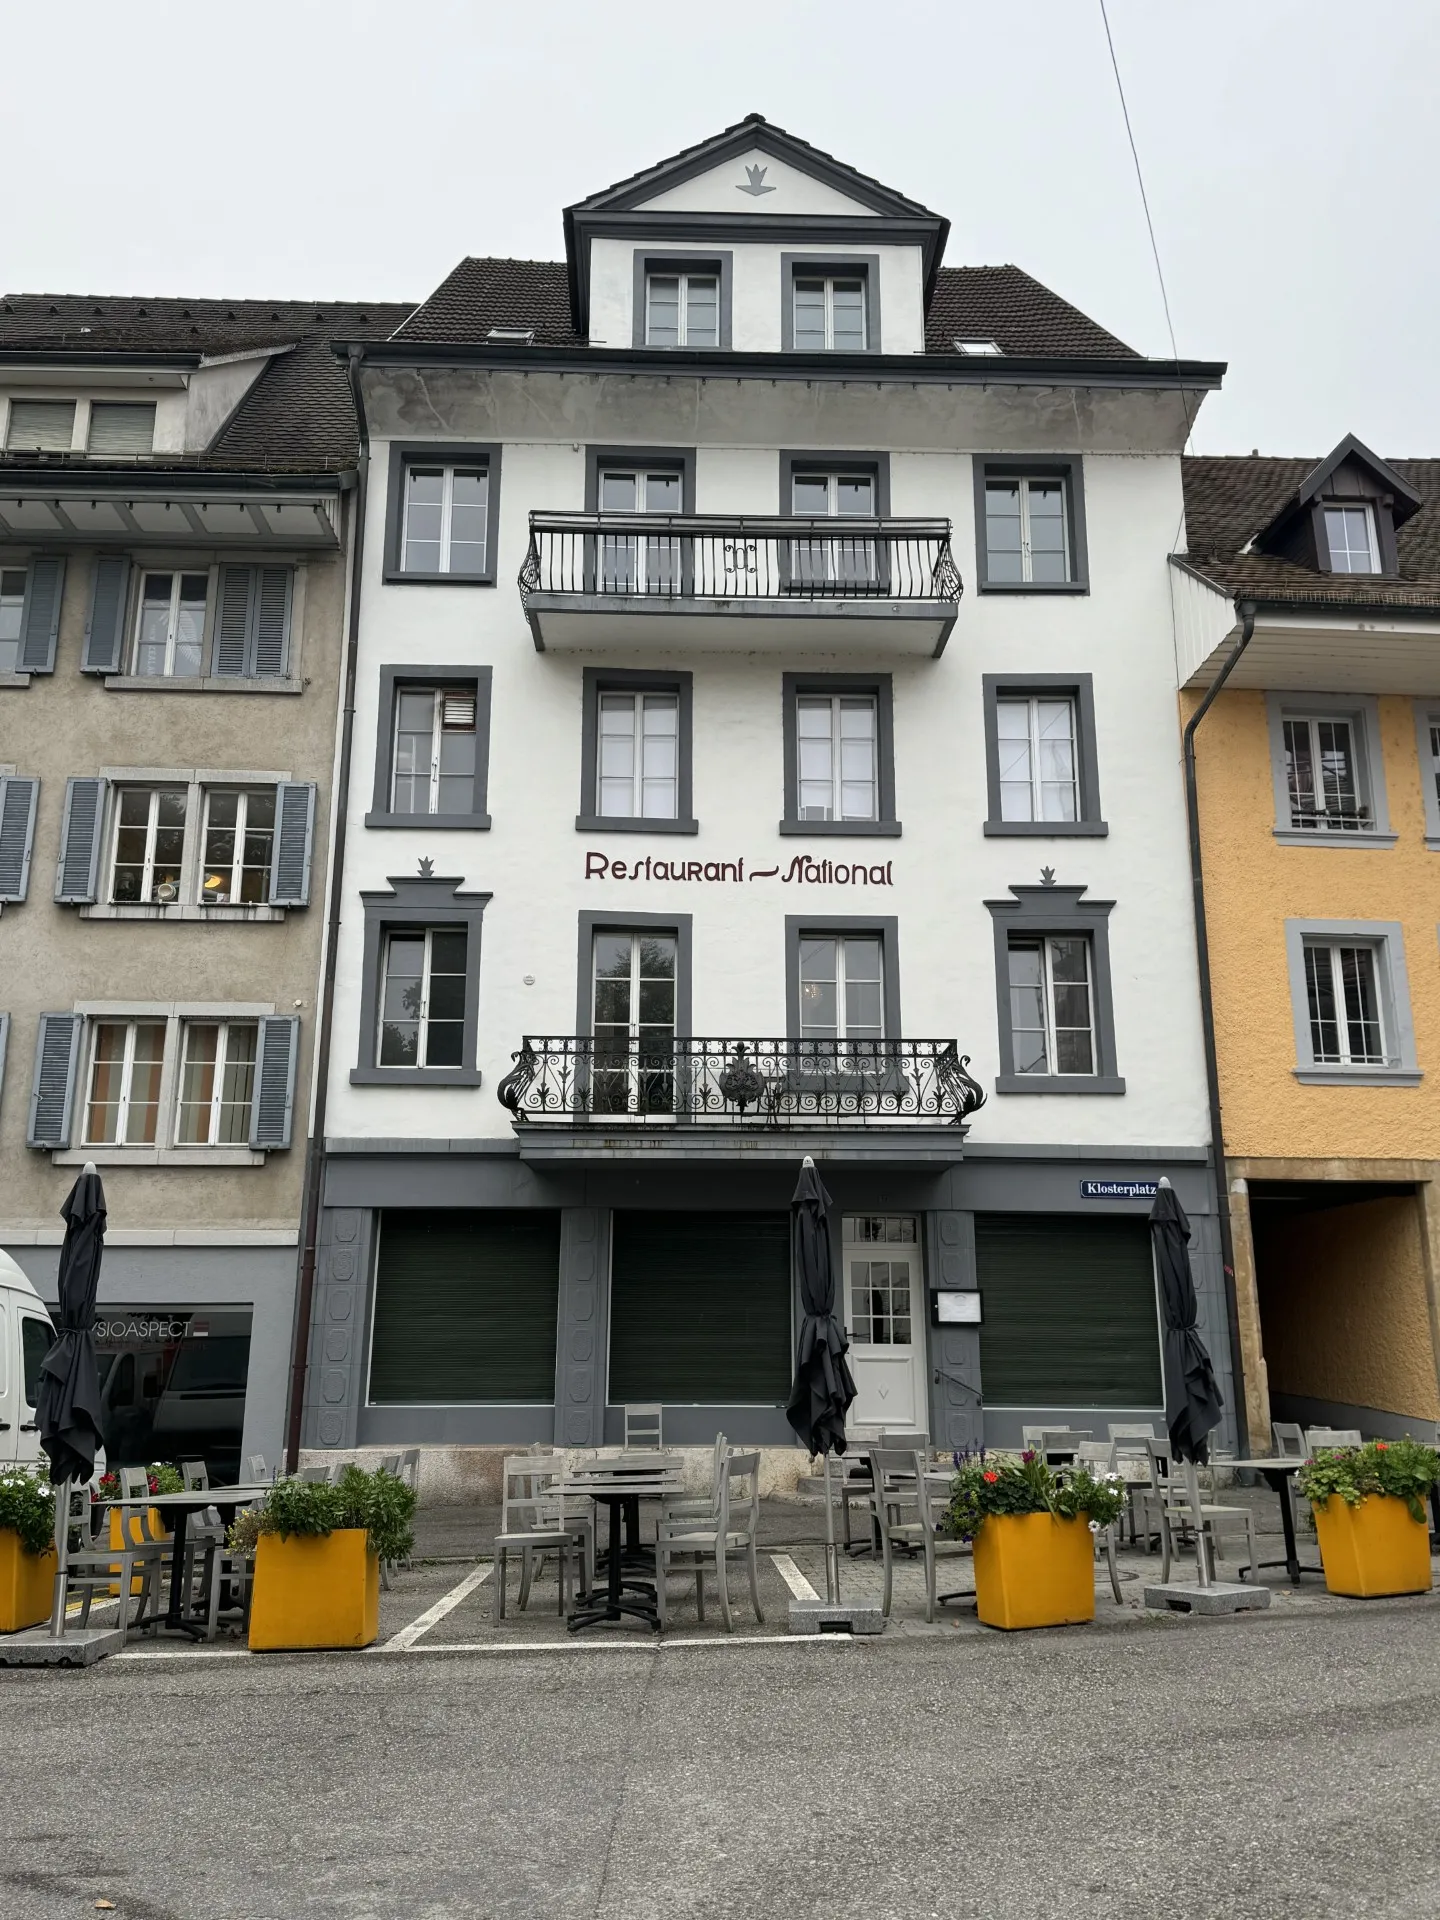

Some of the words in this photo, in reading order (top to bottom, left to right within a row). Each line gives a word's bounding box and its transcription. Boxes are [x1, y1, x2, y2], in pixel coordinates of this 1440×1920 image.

[584, 851, 744, 882] Restaurant
[781, 854, 894, 886] National
[1087, 1183, 1157, 1196] Klosterplatz
